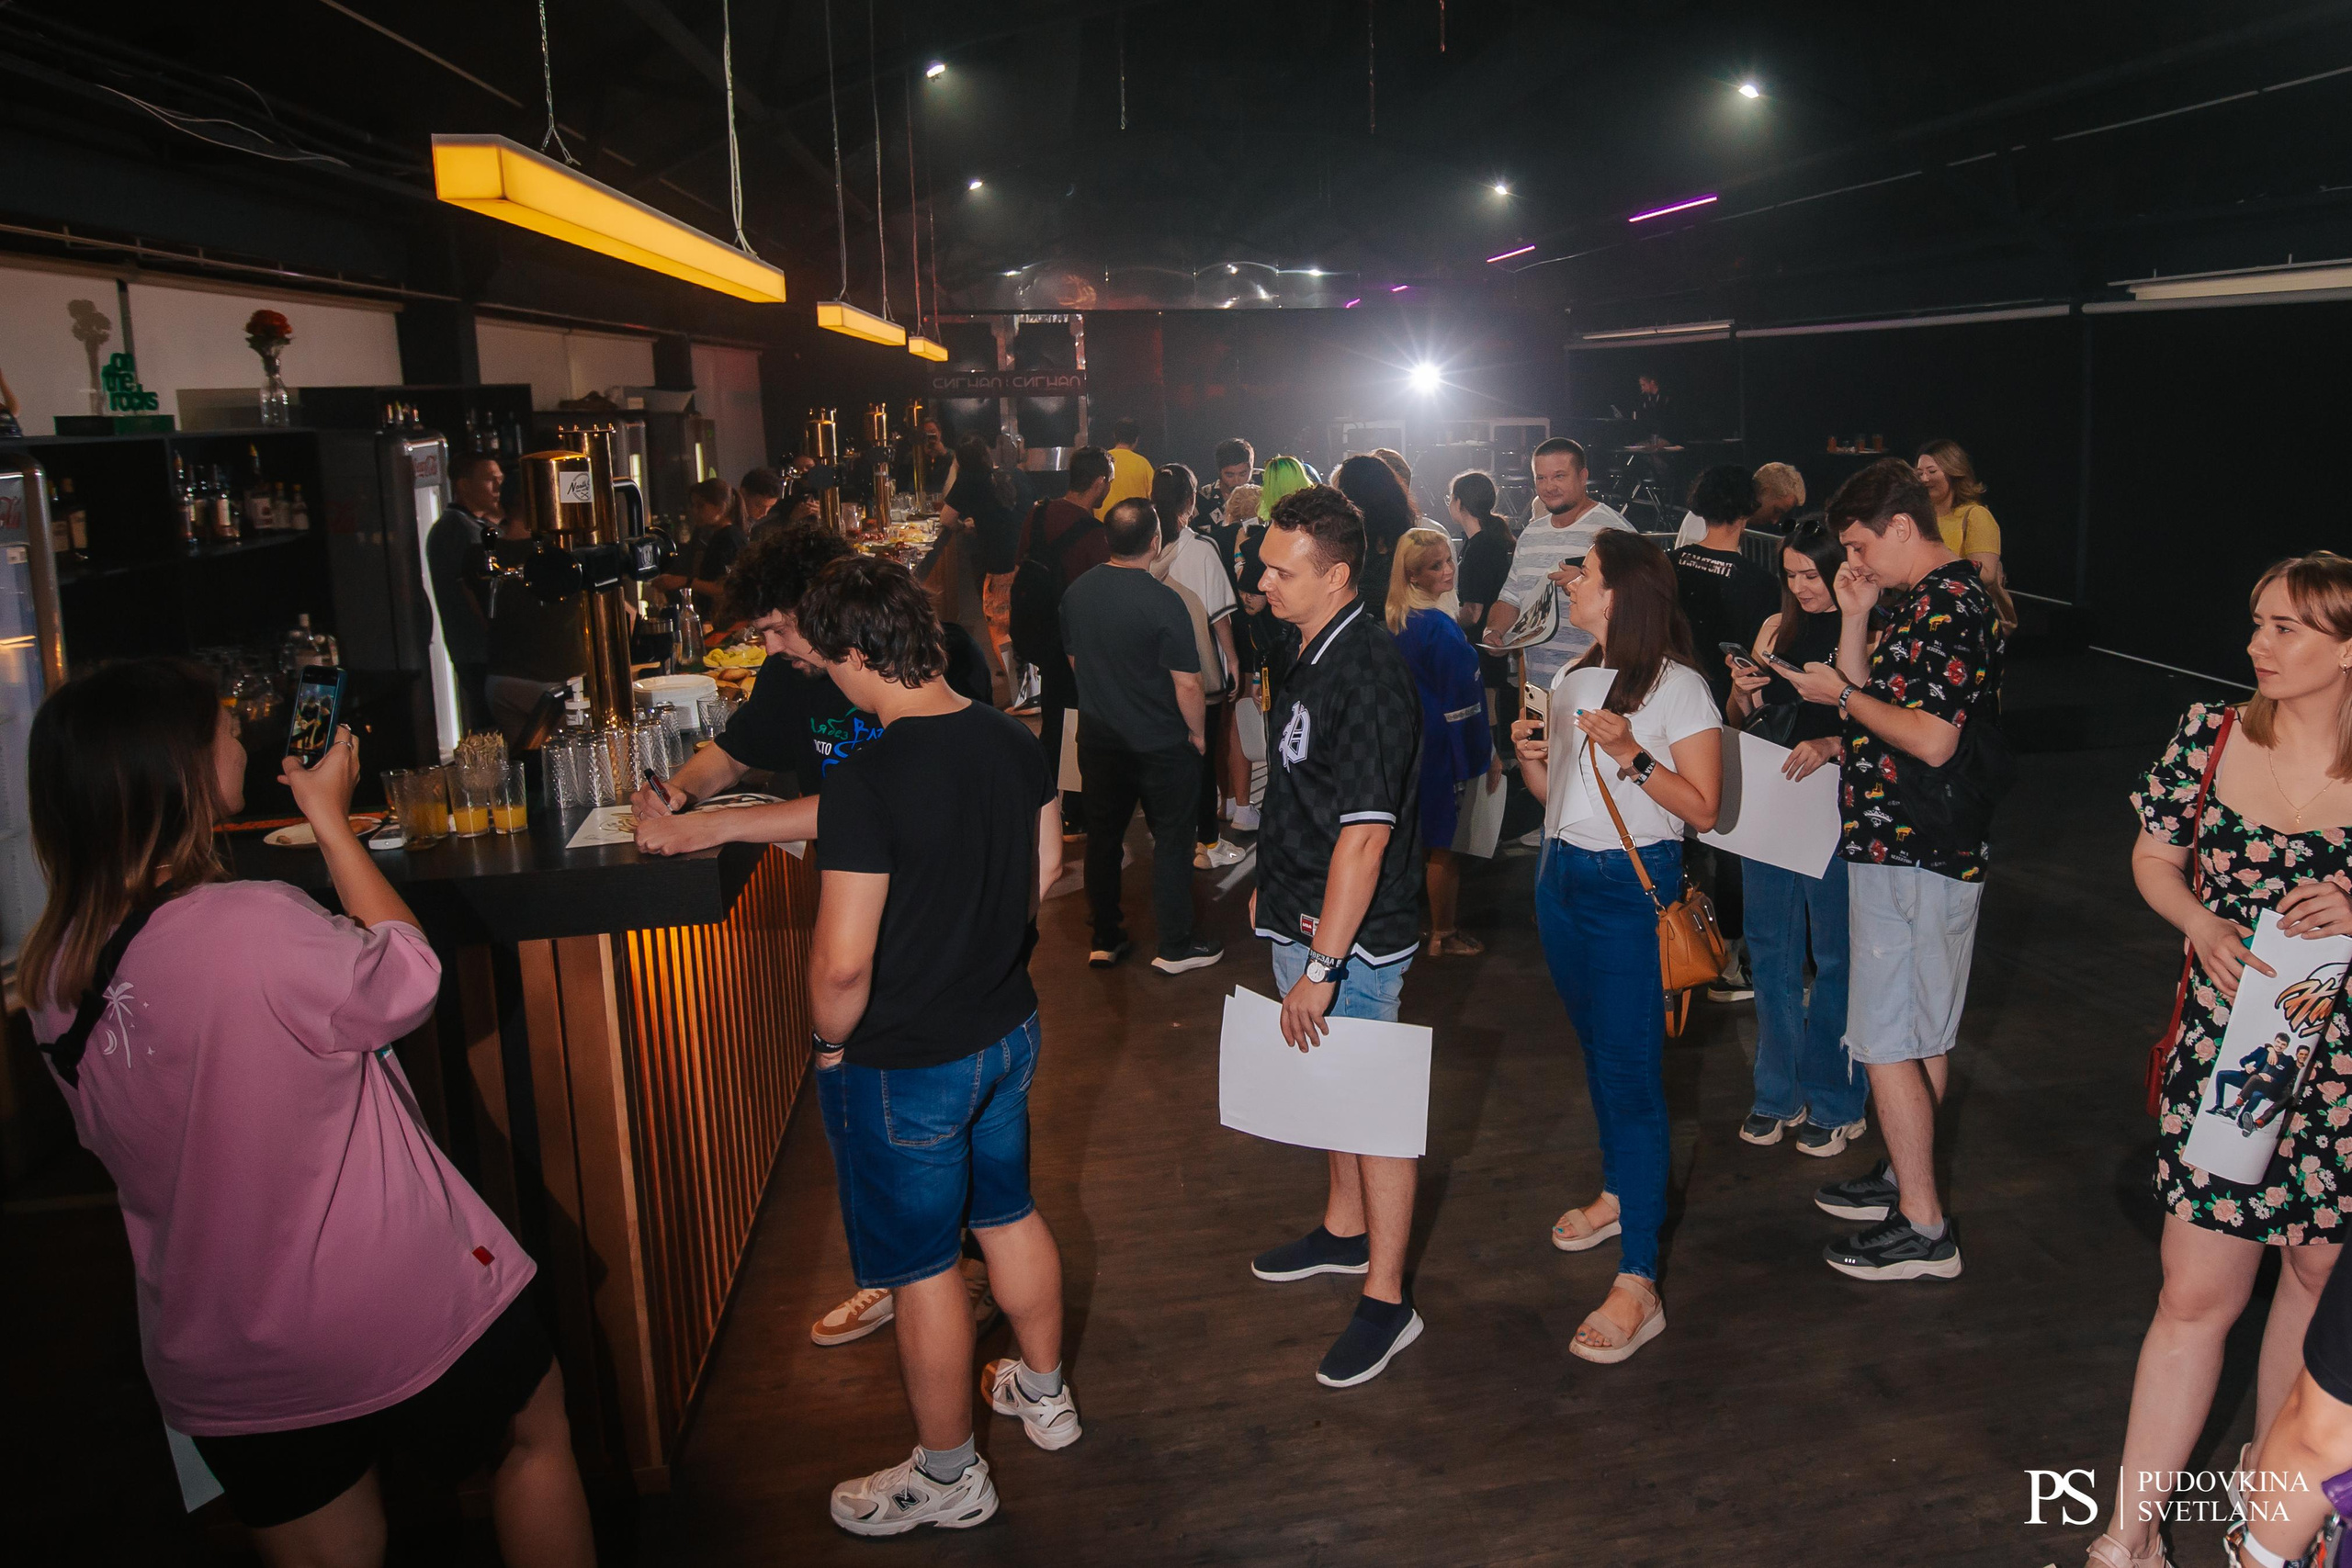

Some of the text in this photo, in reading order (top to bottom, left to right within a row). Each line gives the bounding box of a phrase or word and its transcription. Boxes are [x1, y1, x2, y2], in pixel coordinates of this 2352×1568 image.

[109, 353, 135, 373] on
[101, 364, 135, 392] the
[1012, 375, 1081, 388] СИГНАЛ
[109, 383, 160, 412] rocks
